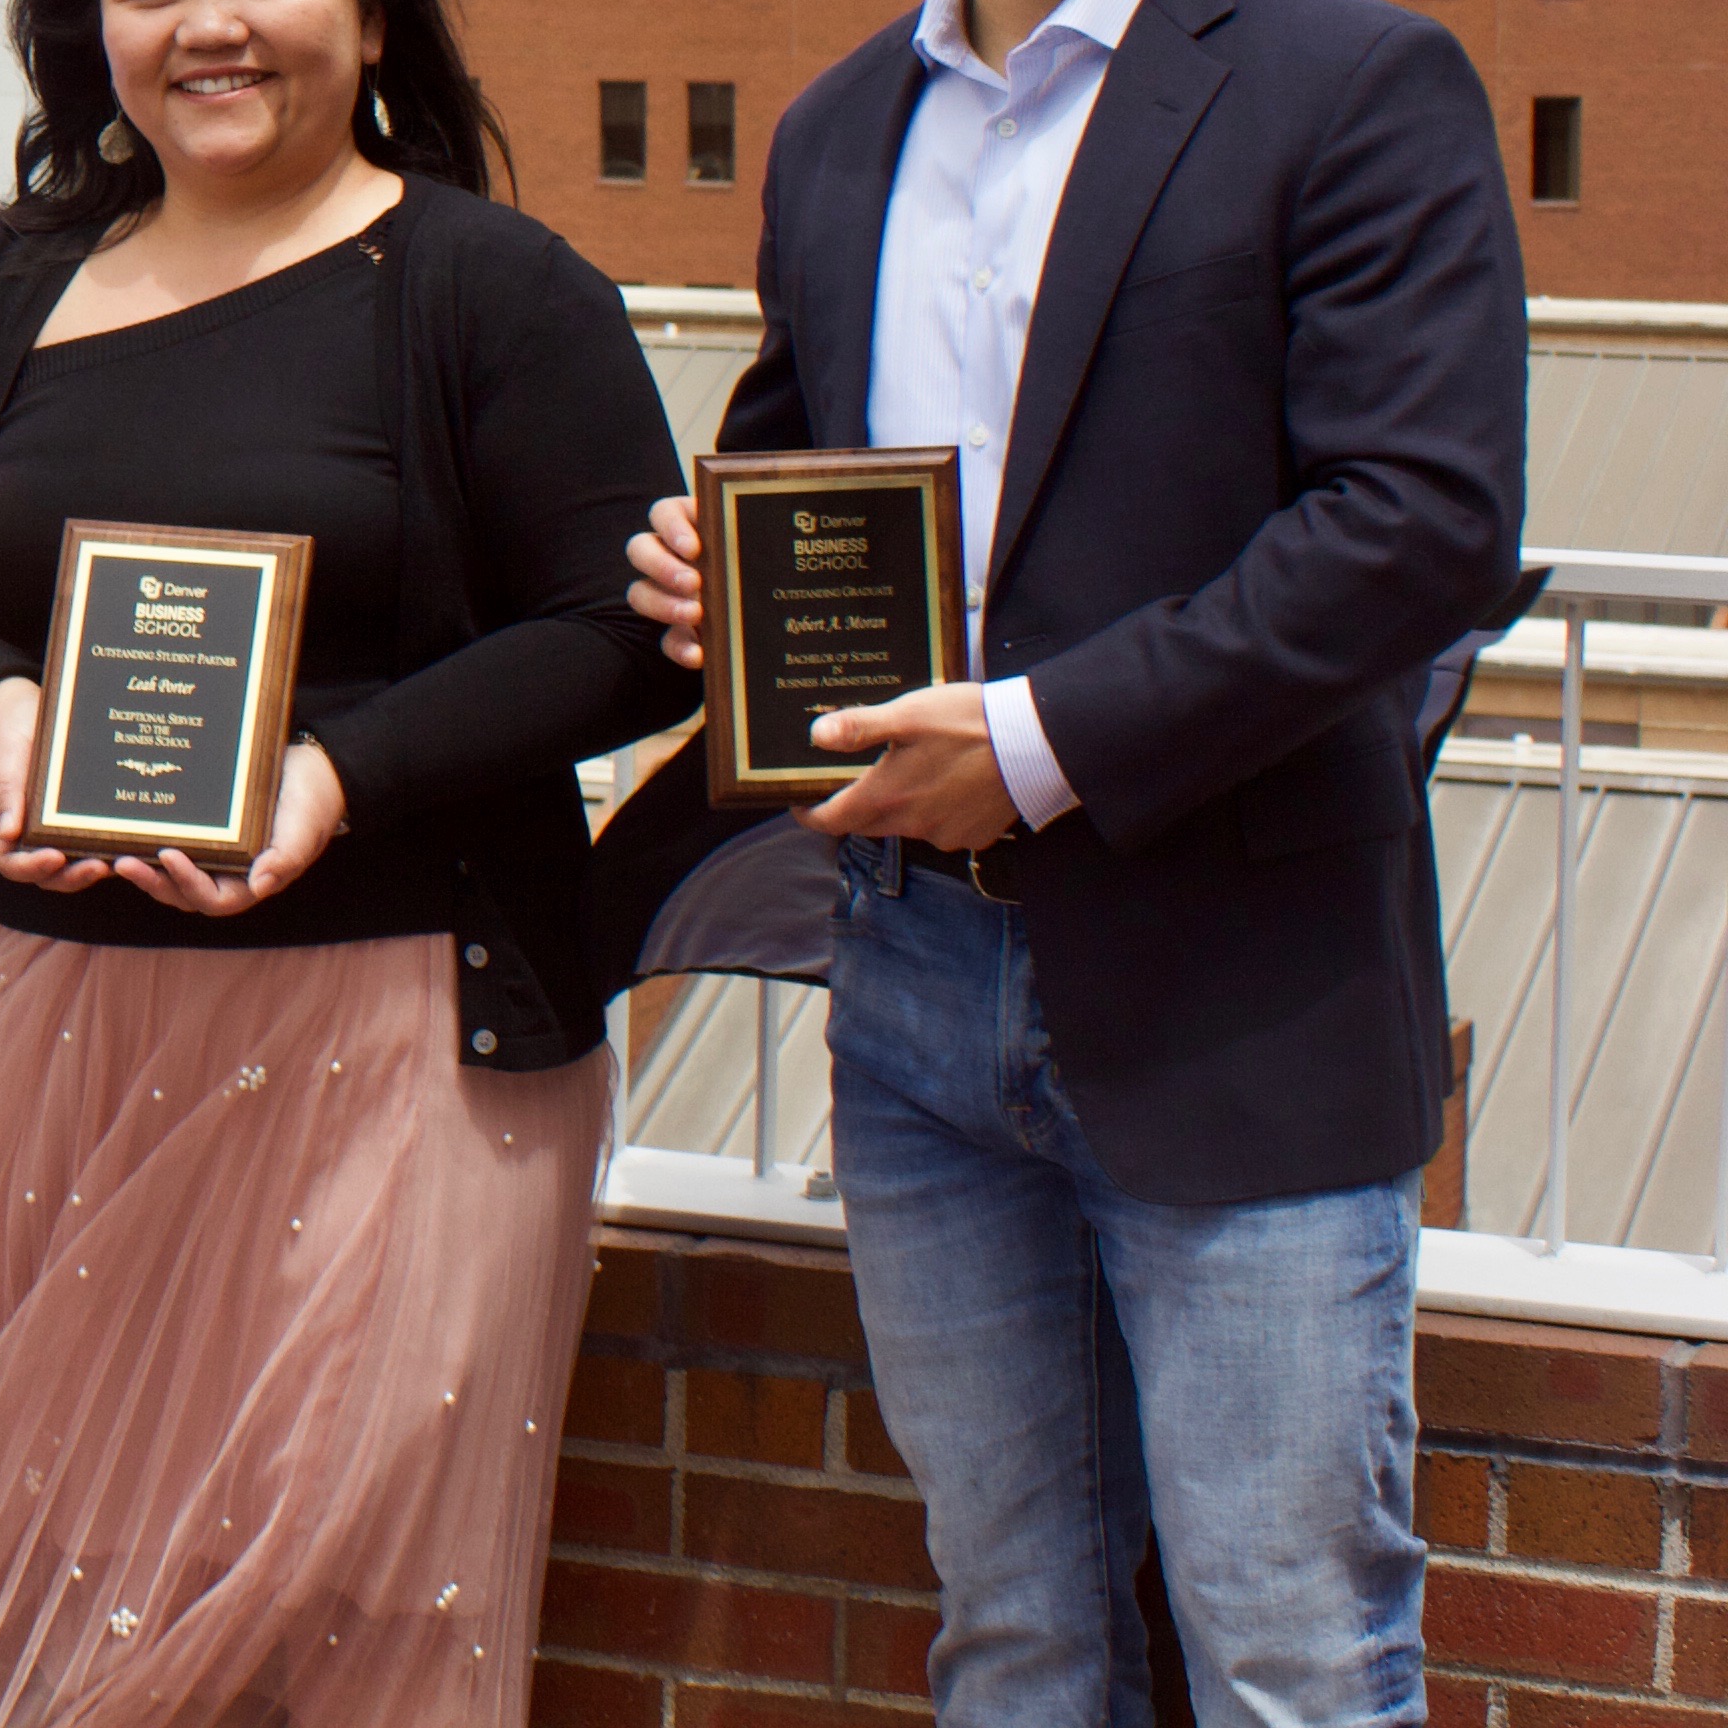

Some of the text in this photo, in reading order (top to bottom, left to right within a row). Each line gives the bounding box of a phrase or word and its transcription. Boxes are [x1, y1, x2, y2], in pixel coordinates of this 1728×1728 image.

[820, 515, 866, 528] Denver
[793, 537, 868, 556] BUSINESS
[795, 555, 869, 572] SCHOOL
[164, 582, 208, 600] Denver
[135, 602, 205, 623] BUSINESS
[133, 621, 201, 638] SCHOOL
[153, 791, 176, 804] 2019
